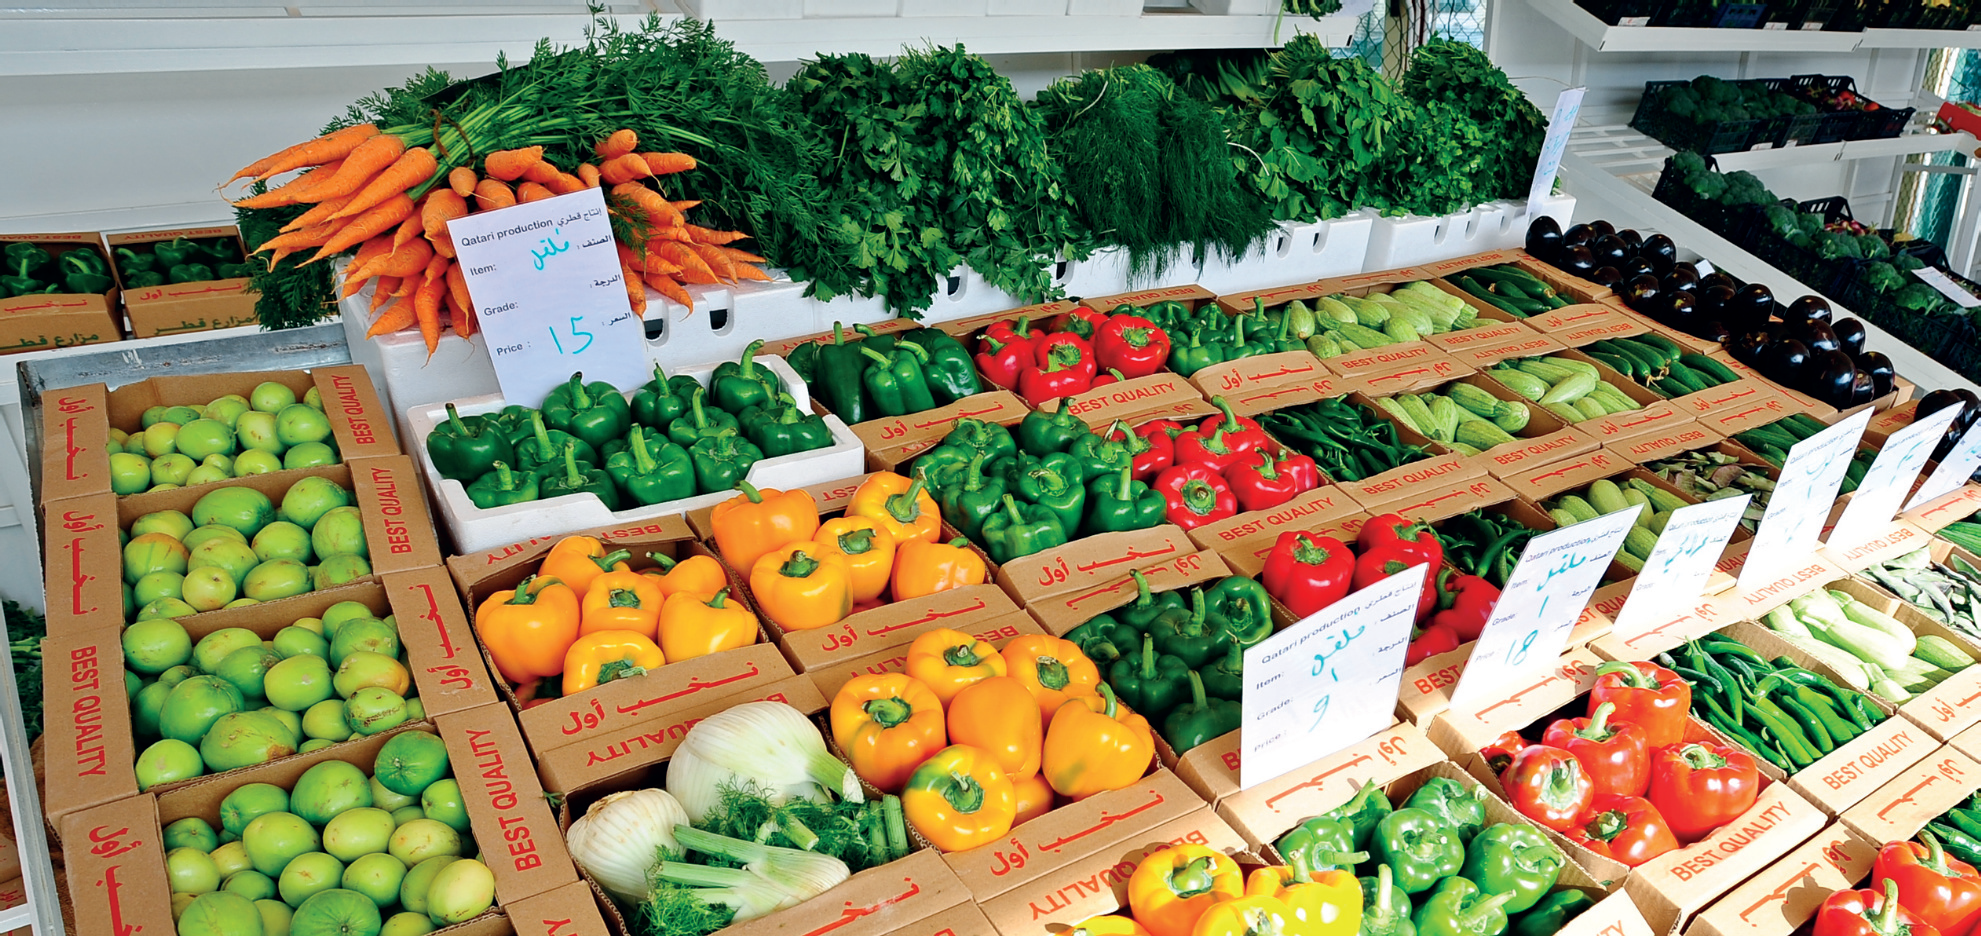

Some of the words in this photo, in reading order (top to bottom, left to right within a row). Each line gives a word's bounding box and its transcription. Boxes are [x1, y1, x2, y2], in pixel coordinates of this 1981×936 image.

[557, 213, 582, 227] قطري
[584, 208, 602, 221] إنتاج
[461, 232, 496, 247] Qatari
[497, 218, 553, 239] production
[470, 263, 497, 276] Item:
[484, 302, 519, 316] Grade:
[0, 334, 47, 350] قط
[497, 342, 523, 356] Price
[550, 316, 593, 355] 15
[1445, 334, 1473, 346] BEST
[1476, 326, 1521, 340] QUALITY
[1341, 357, 1376, 369] BEST
[1376, 347, 1429, 364] QUALITY
[331, 375, 364, 421] QUALITY
[1068, 397, 1109, 416] BEST
[1112, 382, 1177, 404] QUALITY
[348, 421, 376, 445] BEST
[1630, 437, 1677, 455] QUALITY
[1674, 430, 1706, 444] BEST
[1493, 449, 1528, 466] BEST
[1529, 435, 1577, 455] QUALITY
[371, 467, 402, 516] QUALITY
[1363, 480, 1403, 495] BEST
[1403, 461, 1462, 483] QUALITY
[823, 485, 858, 502] EST
[602, 524, 663, 540] BEST
[1218, 520, 1264, 542] BEST
[1266, 496, 1335, 526] QUALITY
[384, 516, 412, 554] BEST
[1888, 528, 1915, 545] BEST
[1525, 549, 1549, 563] Qatari
[1550, 538, 1591, 556] production
[1842, 537, 1891, 561] QUALITY
[1794, 564, 1827, 582] BEST
[1743, 579, 1796, 606] QUALITY
[973, 625, 1019, 642] BES
[1261, 641, 1298, 664] Qatari
[1300, 606, 1361, 644] production
[1505, 629, 1539, 666] 18
[71, 645, 99, 691] BEST
[1256, 672, 1284, 690] Item:
[1414, 664, 1461, 695] BEST
[1257, 698, 1293, 721] Grade:
[72, 695, 107, 777] QUALITY
[586, 718, 704, 767] QUALITY
[466, 729, 518, 810] QUALITY
[1822, 761, 1865, 791] BEST
[1859, 731, 1914, 769] QUALITY
[498, 816, 542, 872] BEST
[1670, 849, 1723, 882] BEST
[1719, 801, 1792, 855] QUALITY
[1028, 860, 1138, 922] QUALITY
